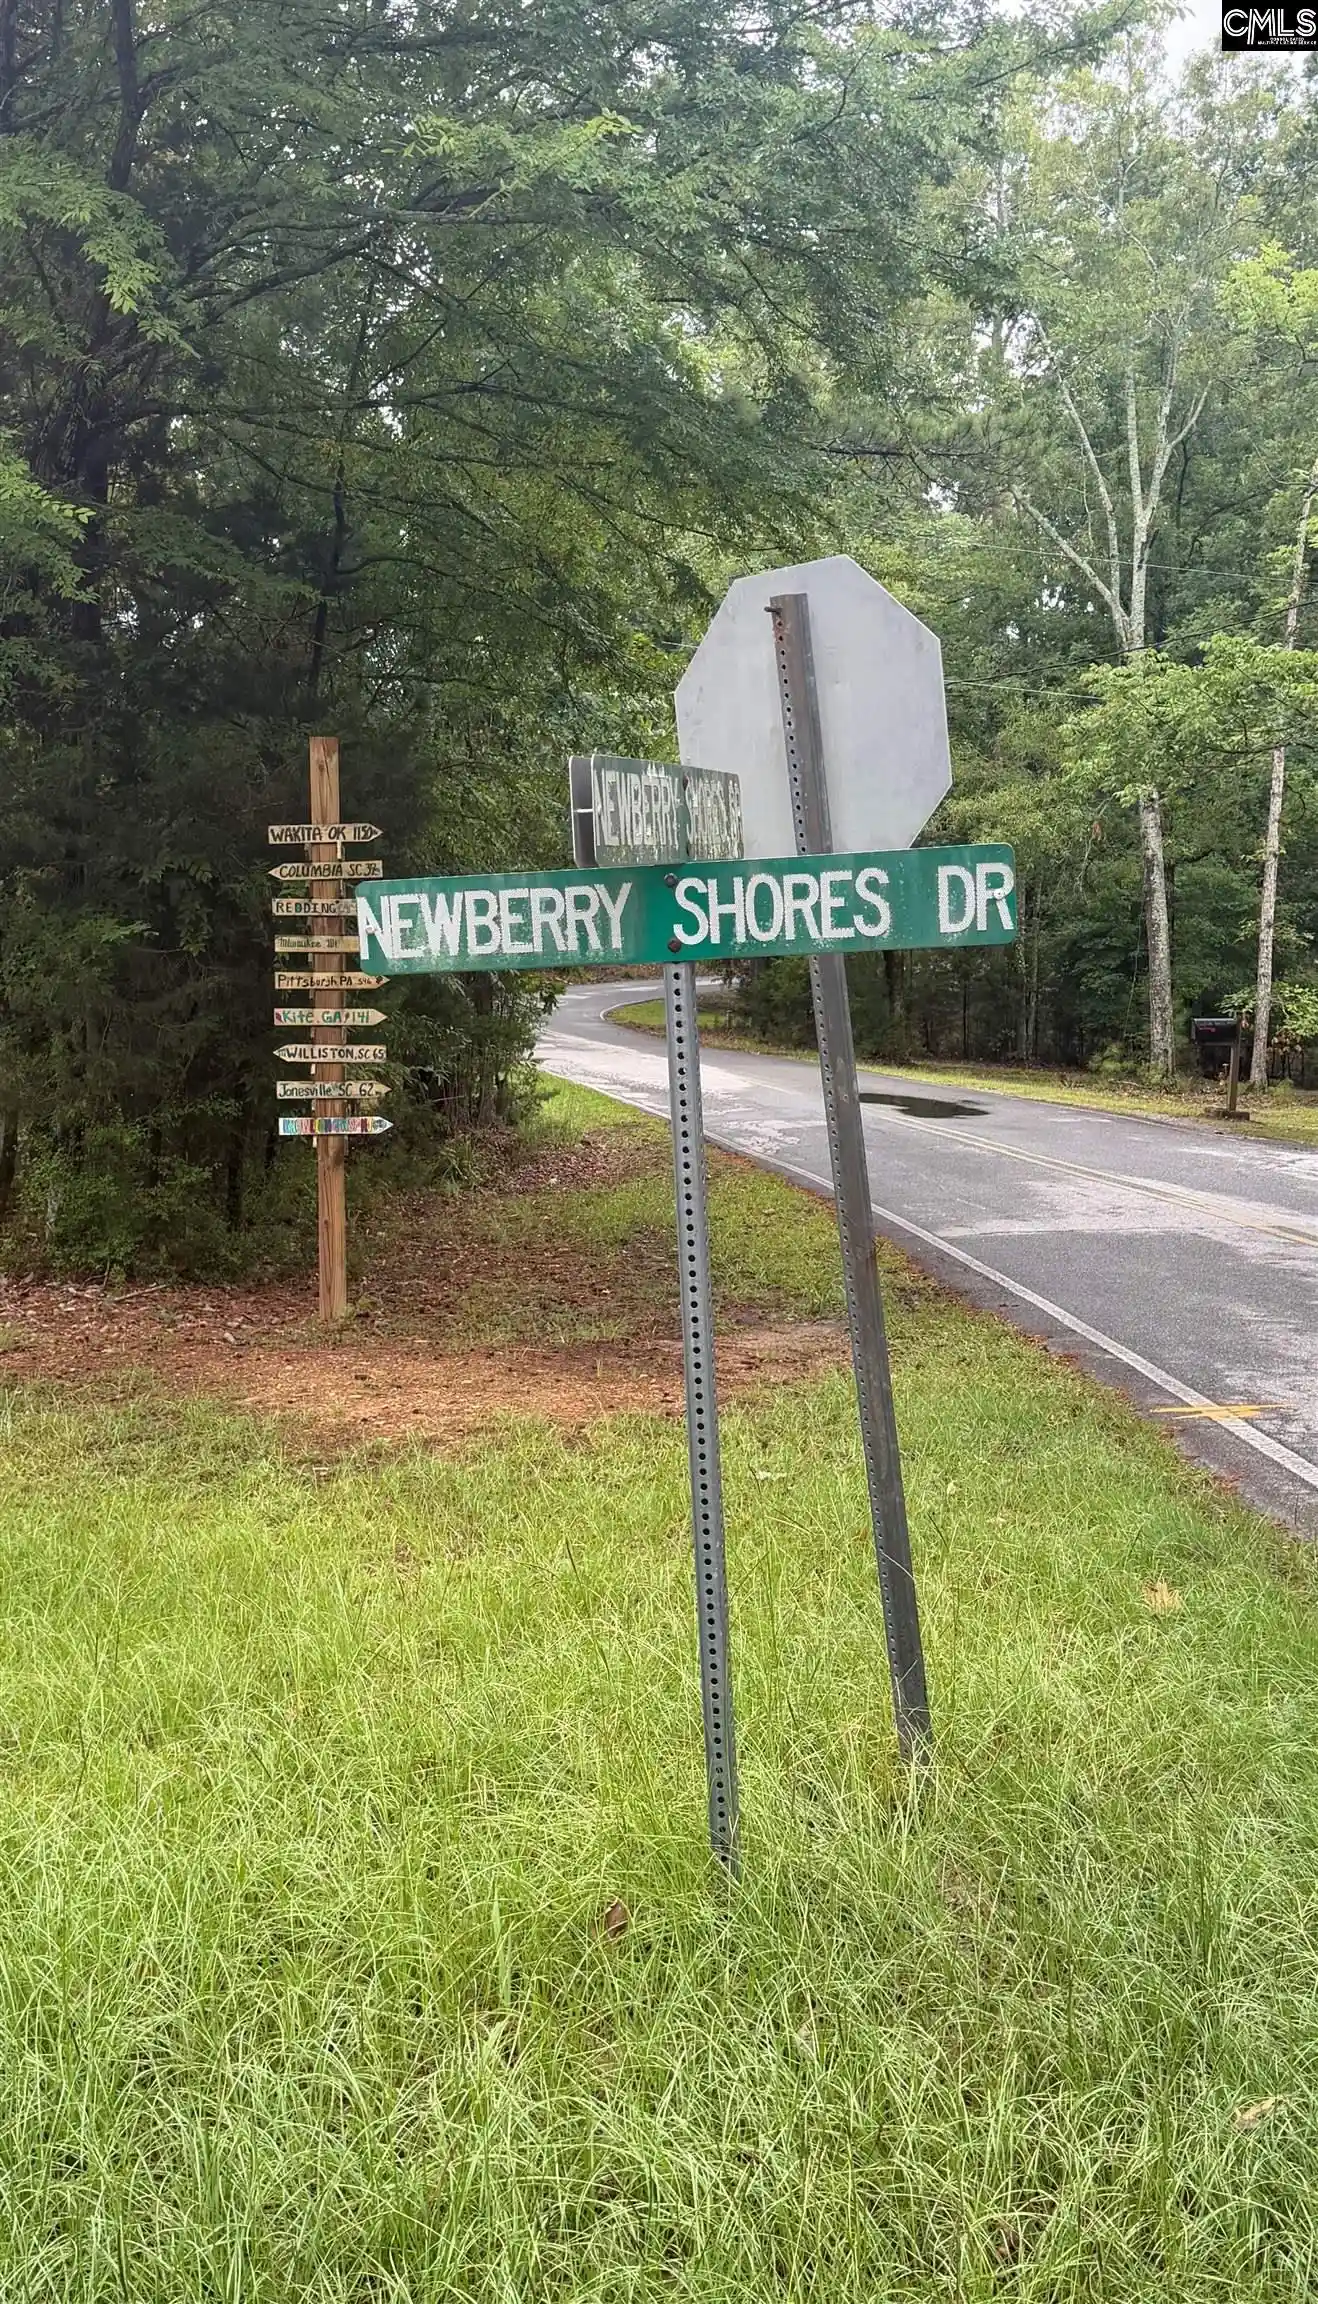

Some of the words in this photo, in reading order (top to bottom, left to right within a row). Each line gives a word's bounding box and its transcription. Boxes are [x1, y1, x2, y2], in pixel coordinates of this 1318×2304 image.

[593, 768, 679, 850] NEWBERRY
[270, 827, 323, 842] WAKITA
[328, 826, 347, 841] OK
[279, 864, 343, 878] COLUMBIA
[347, 863, 362, 876] SC
[276, 902, 337, 914] REDDING
[356, 882, 632, 960] NEWBERRY
[673, 867, 892, 945] SHORES
[937, 862, 1015, 933] DR
[339, 975, 353, 987] PA
[358, 1048, 370, 1060] SC
[338, 1083, 353, 1097] SC
